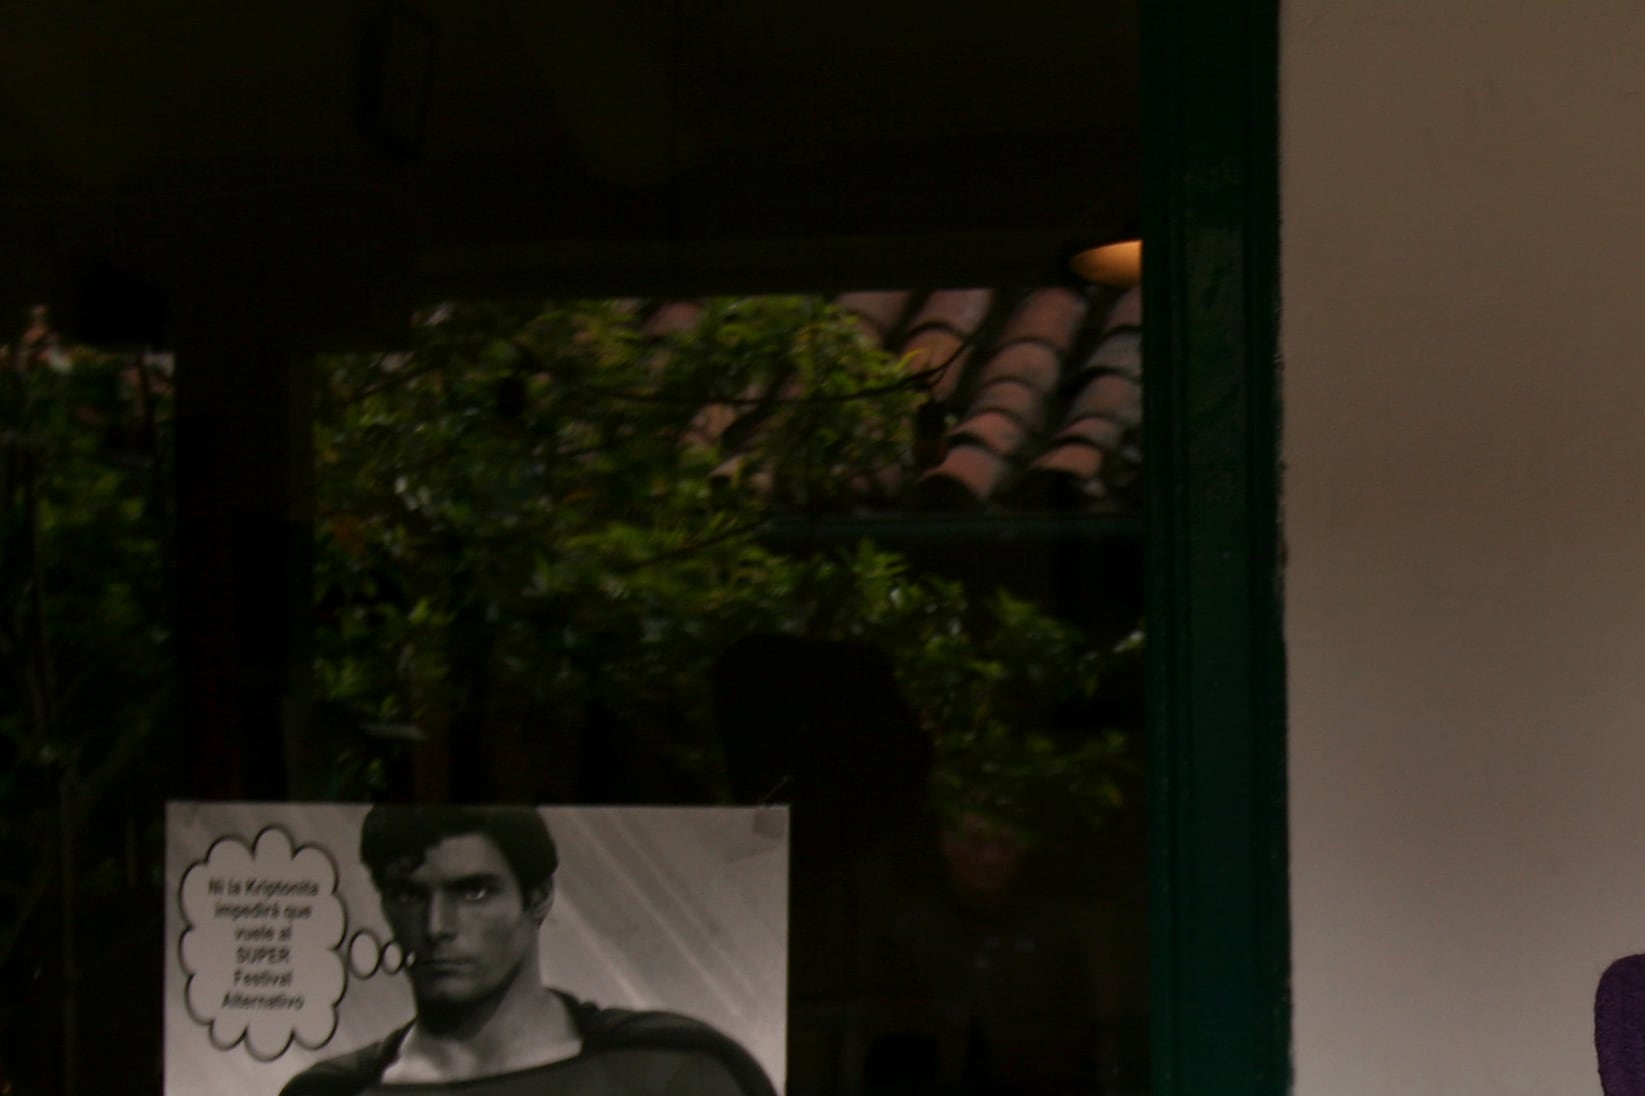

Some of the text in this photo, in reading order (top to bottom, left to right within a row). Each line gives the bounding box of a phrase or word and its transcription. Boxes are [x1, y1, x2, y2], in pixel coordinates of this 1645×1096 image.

[208, 878, 224, 895] Ni
[227, 879, 241, 896] la
[283, 905, 312, 922] que
[235, 925, 291, 941] vuele al
[236, 946, 290, 963] SUPER
[234, 968, 292, 985] Festival
[221, 992, 304, 1009] Alternativo
